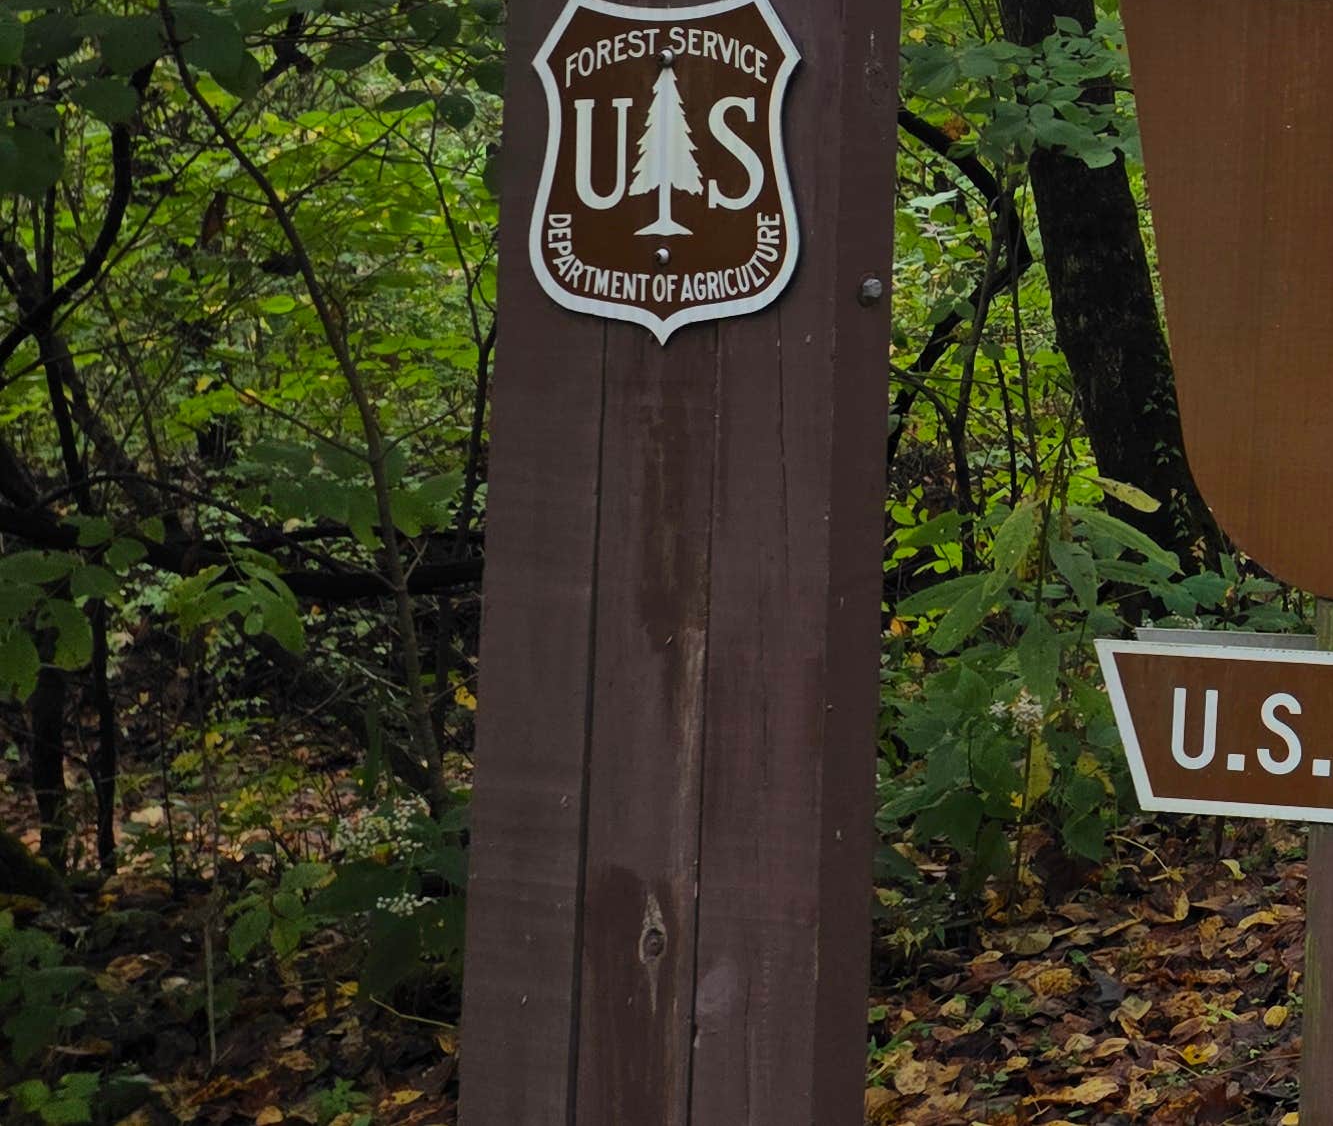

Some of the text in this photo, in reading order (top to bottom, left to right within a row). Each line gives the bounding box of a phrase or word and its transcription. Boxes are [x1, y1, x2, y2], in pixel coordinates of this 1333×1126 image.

[565, 26, 769, 87] FOREST SERVICE
[574, 96, 764, 210] U S
[547, 212, 780, 303] DEPARTMENT OF AGRICULTURE
[1170, 689, 1332, 778] U.S.
